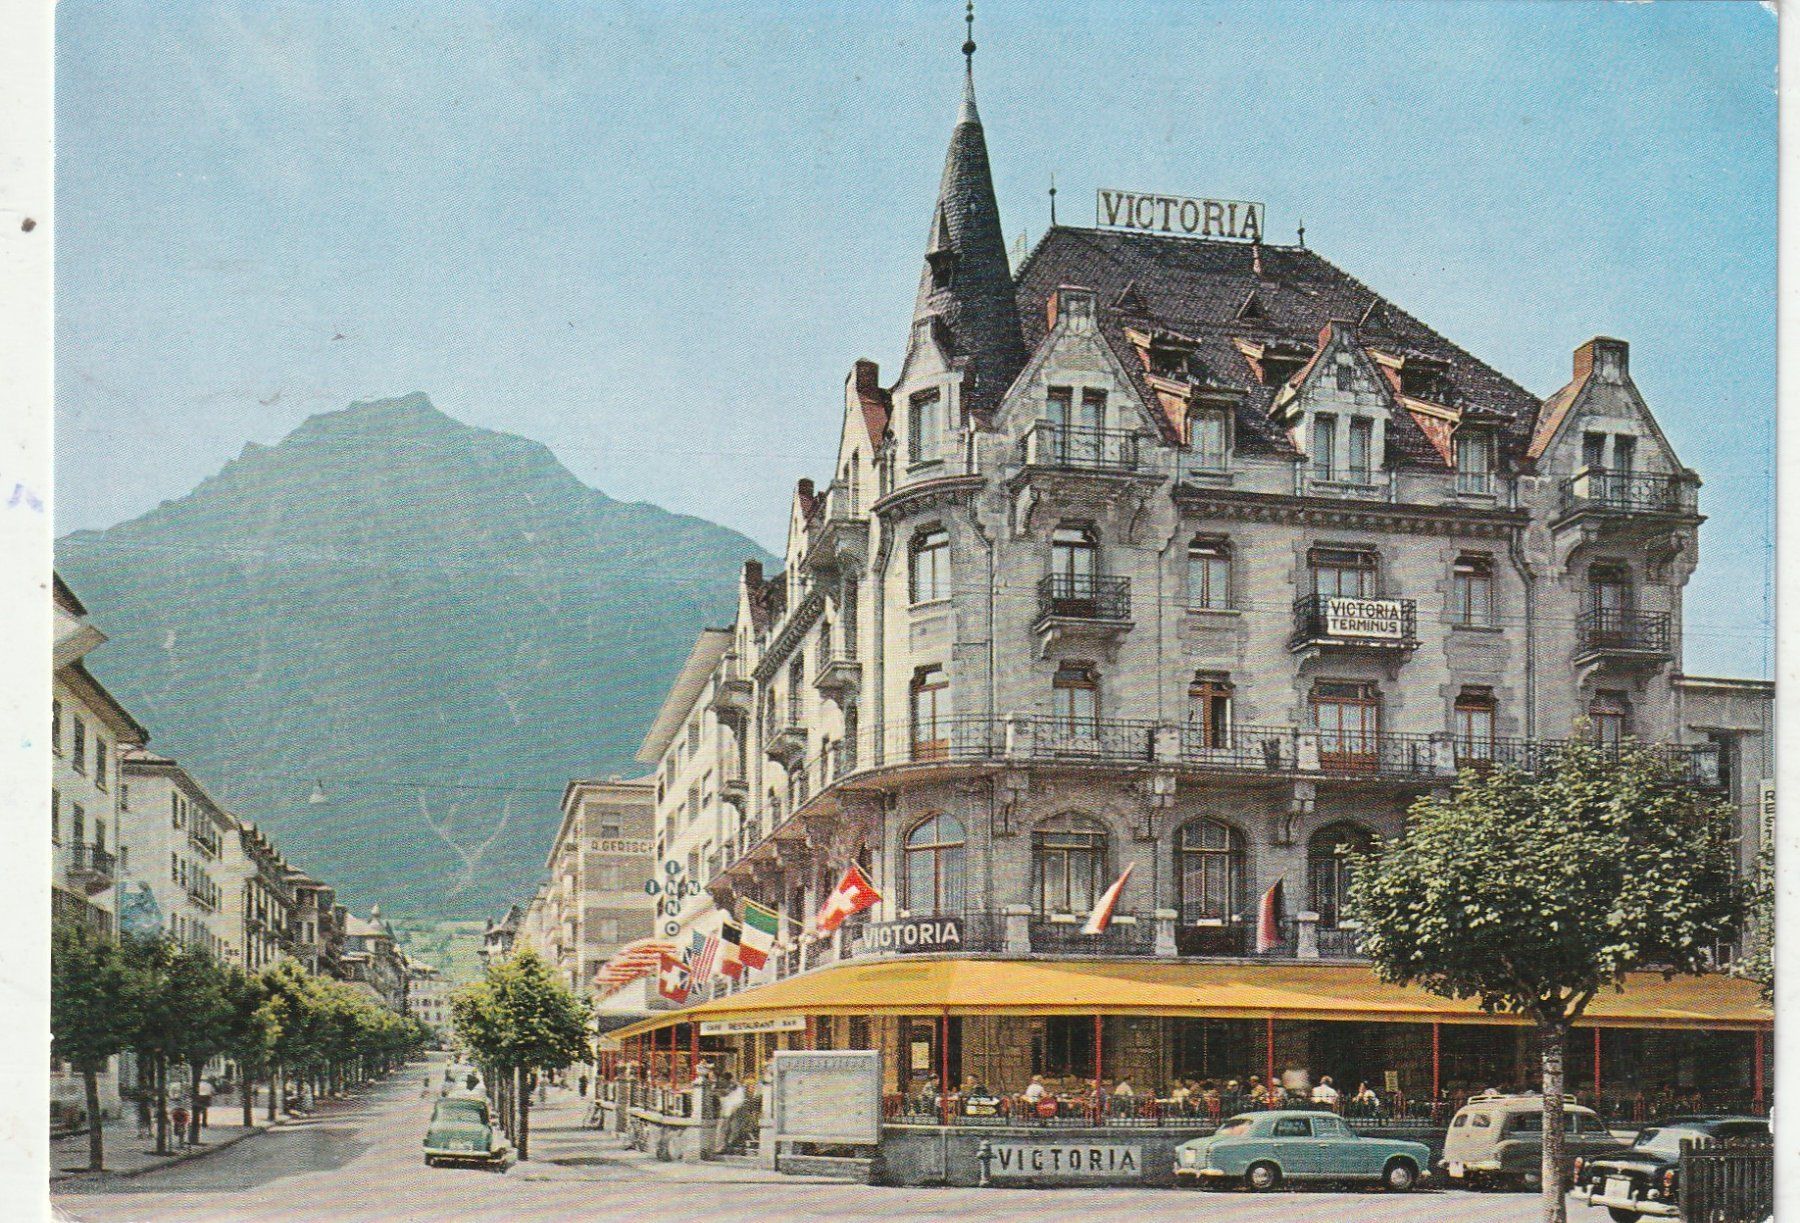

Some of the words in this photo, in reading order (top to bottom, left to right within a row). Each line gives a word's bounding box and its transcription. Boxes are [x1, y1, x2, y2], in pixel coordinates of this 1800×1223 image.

[1102, 191, 1260, 239] VICTORIA
[1331, 601, 1399, 620] VICTORIA
[1331, 619, 1397, 633] TERMINUS
[862, 921, 960, 949] VICTORIA
[998, 1148, 1136, 1171] VICTORIA
